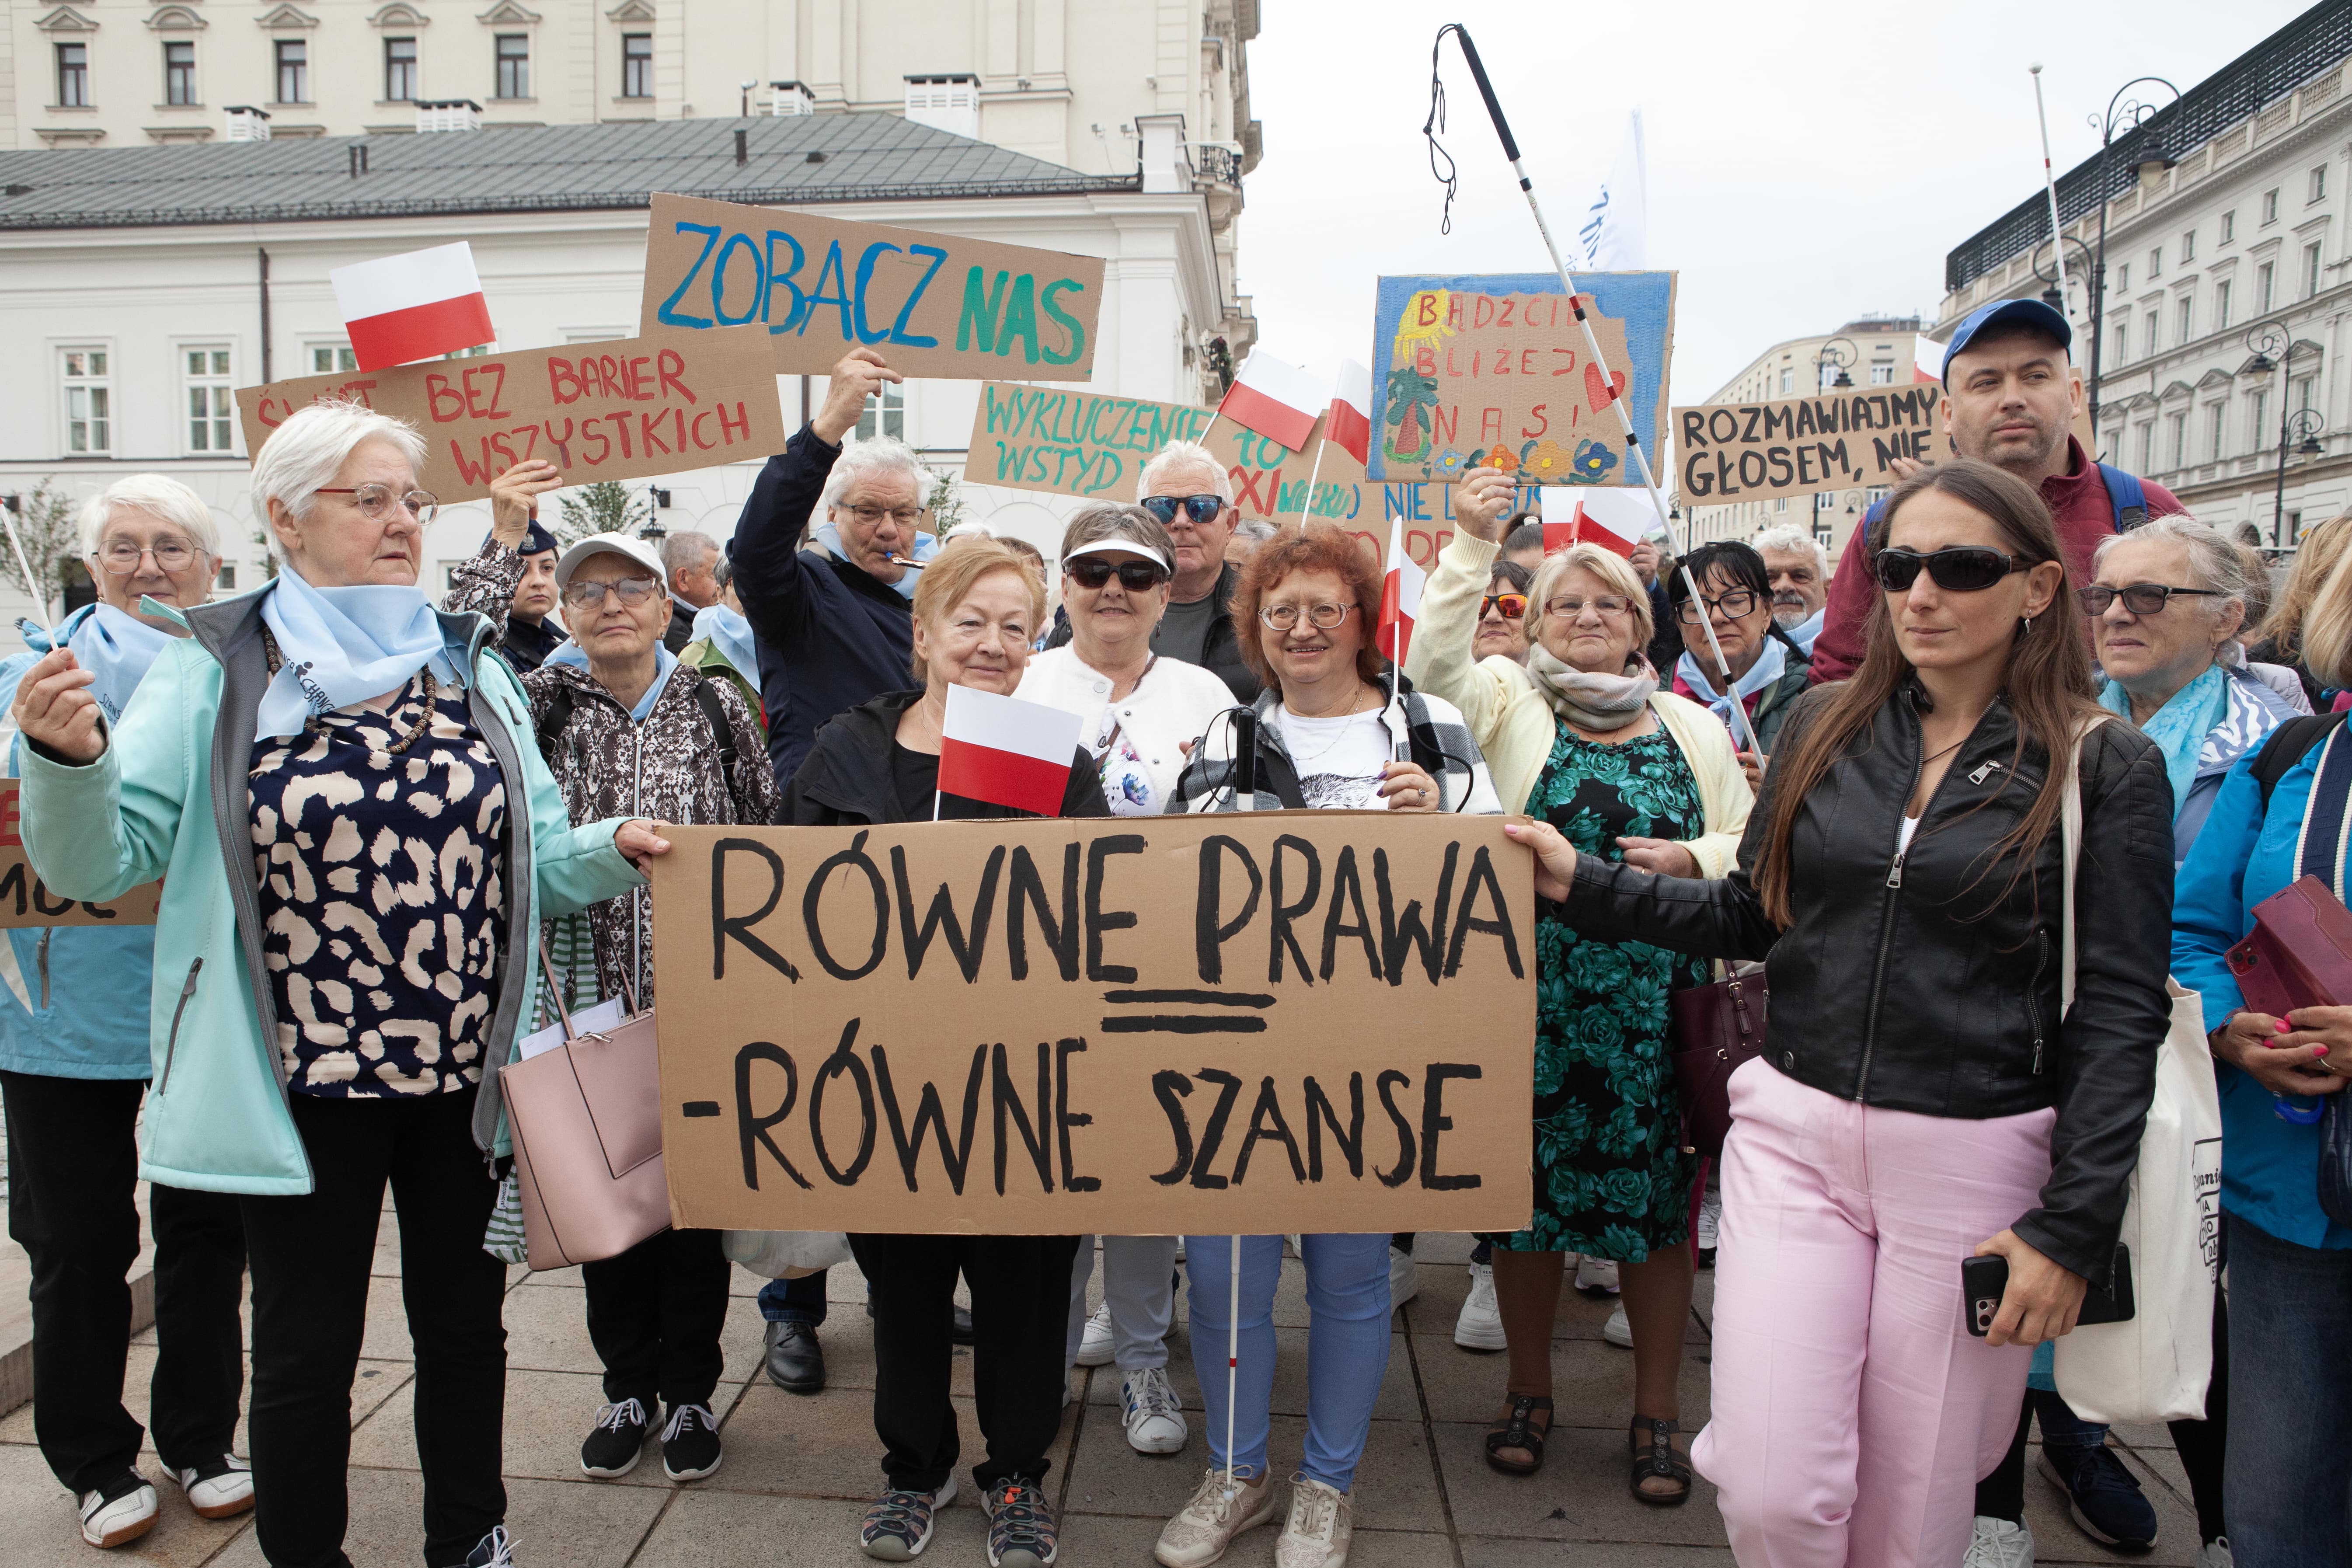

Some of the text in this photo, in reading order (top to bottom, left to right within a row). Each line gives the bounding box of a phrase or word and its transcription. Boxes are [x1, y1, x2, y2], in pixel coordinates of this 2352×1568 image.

[658, 221, 1085, 365] ZOBACZ NAS
[1417, 343, 1575, 378] BLIŻEJ
[426, 363, 511, 423] BEZ
[986, 386, 1220, 453] WYKLUCZENIE
[1433, 404, 1579, 445] NAS!
[1683, 387, 1938, 448] ROZMAWIAJMY
[450, 401, 750, 486] WSZYSTKICH
[997, 441, 1123, 495] WSTYD
[1685, 428, 1934, 497] GŁOSEM, NIE
[1384, 483, 1432, 522] NIE
[711, 829, 1525, 986] RÓWNE PRAWA
[1150, 1063, 1482, 1191] SZANSE
